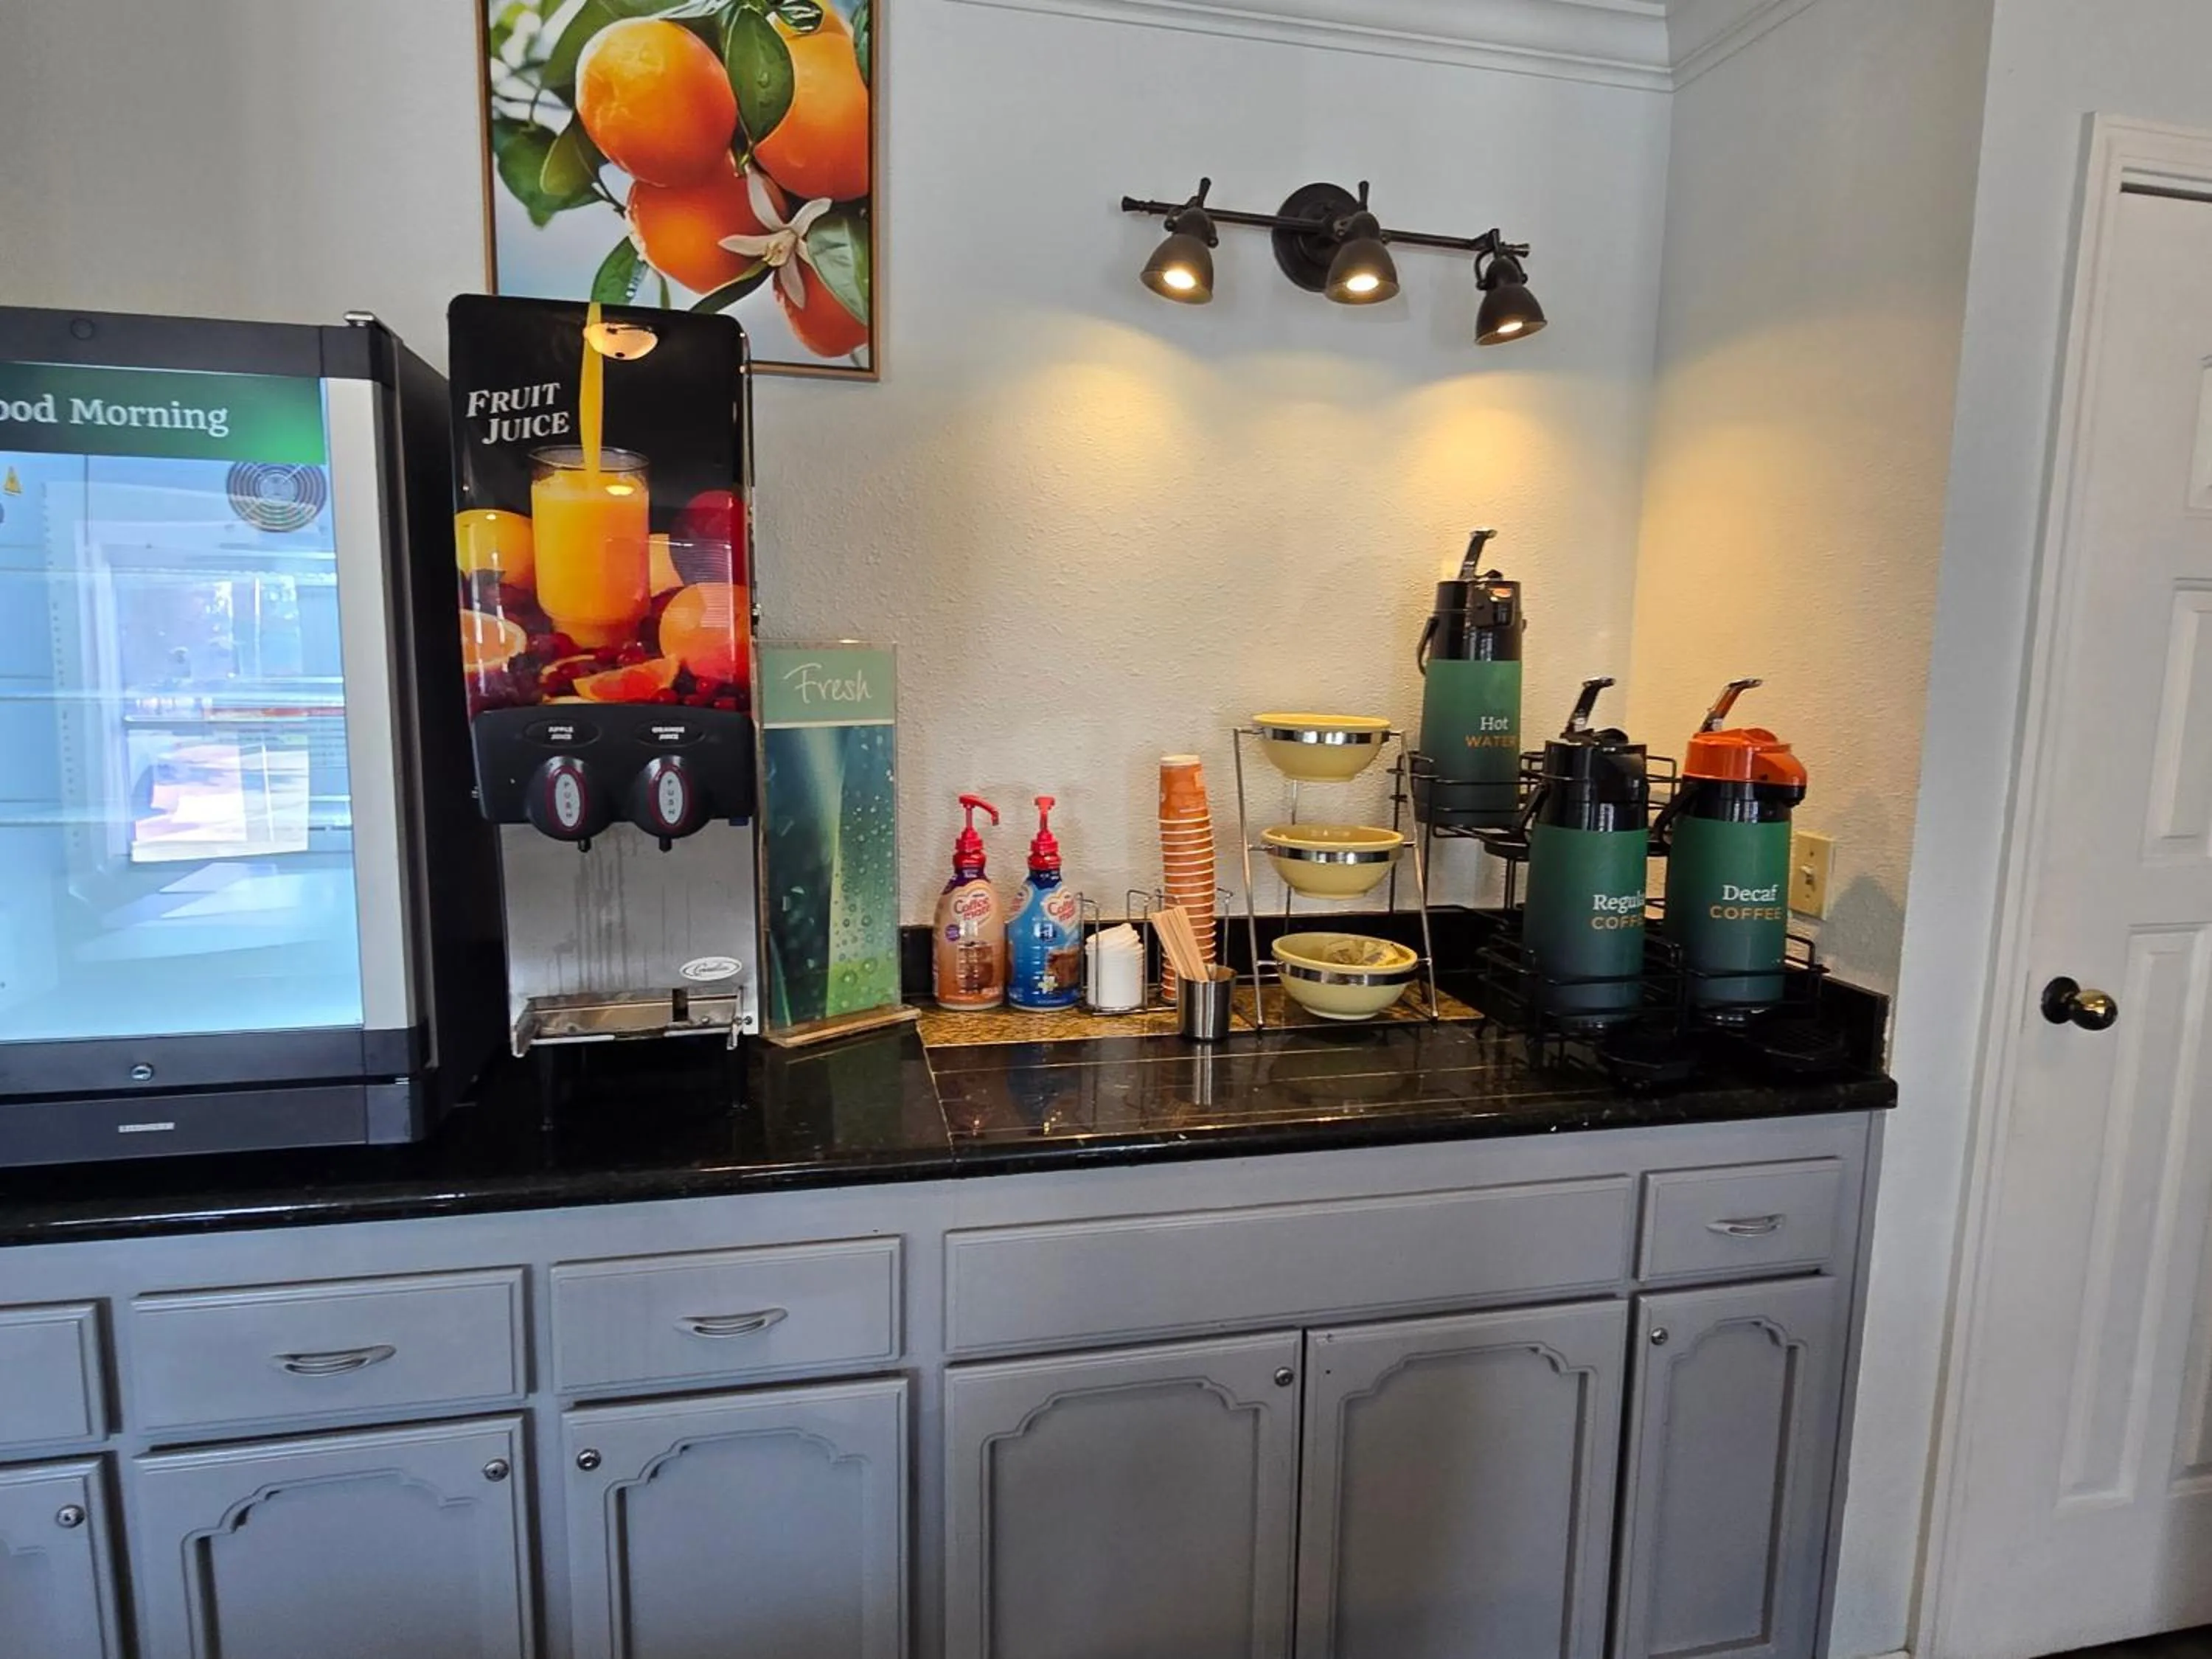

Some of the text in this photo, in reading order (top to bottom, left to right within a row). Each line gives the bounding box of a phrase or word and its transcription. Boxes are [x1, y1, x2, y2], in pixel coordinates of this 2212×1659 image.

[465, 382, 561, 418] FRUIT
[69, 398, 229, 437] Morning
[481, 411, 571, 445] JUICE
[783, 662, 873, 704] Fresh
[1480, 716, 1509, 731] Hot
[1722, 884, 1778, 902] Decaf
[1710, 905, 1782, 920] COFFEE
